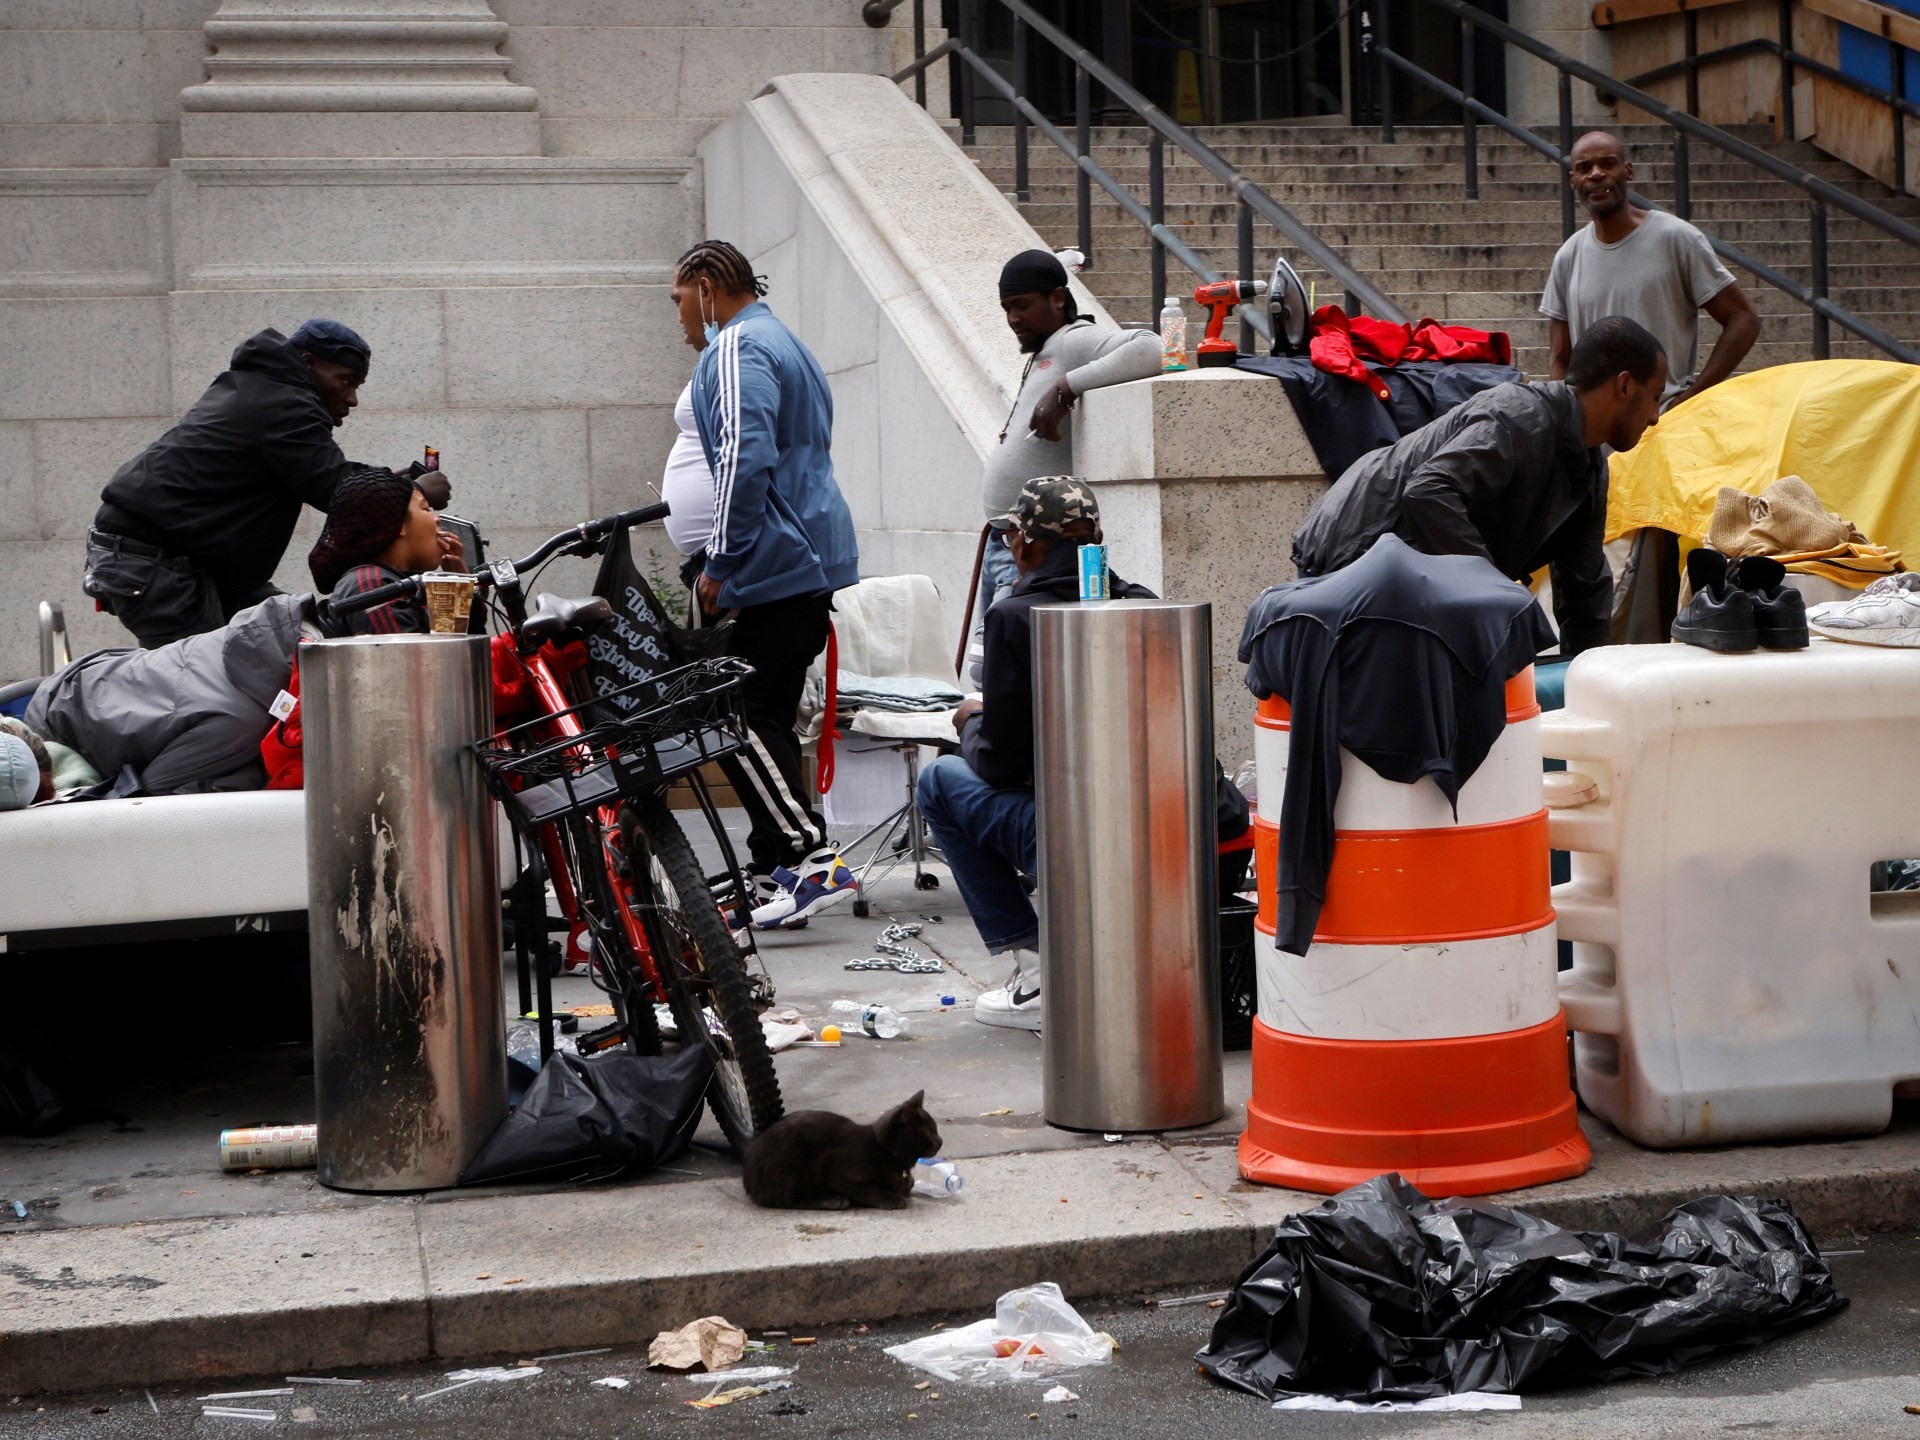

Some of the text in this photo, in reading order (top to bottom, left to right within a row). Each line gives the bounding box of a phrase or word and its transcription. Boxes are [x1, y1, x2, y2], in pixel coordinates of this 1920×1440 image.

[611, 611, 669, 661] You for
[590, 634, 669, 698] Shoppig
